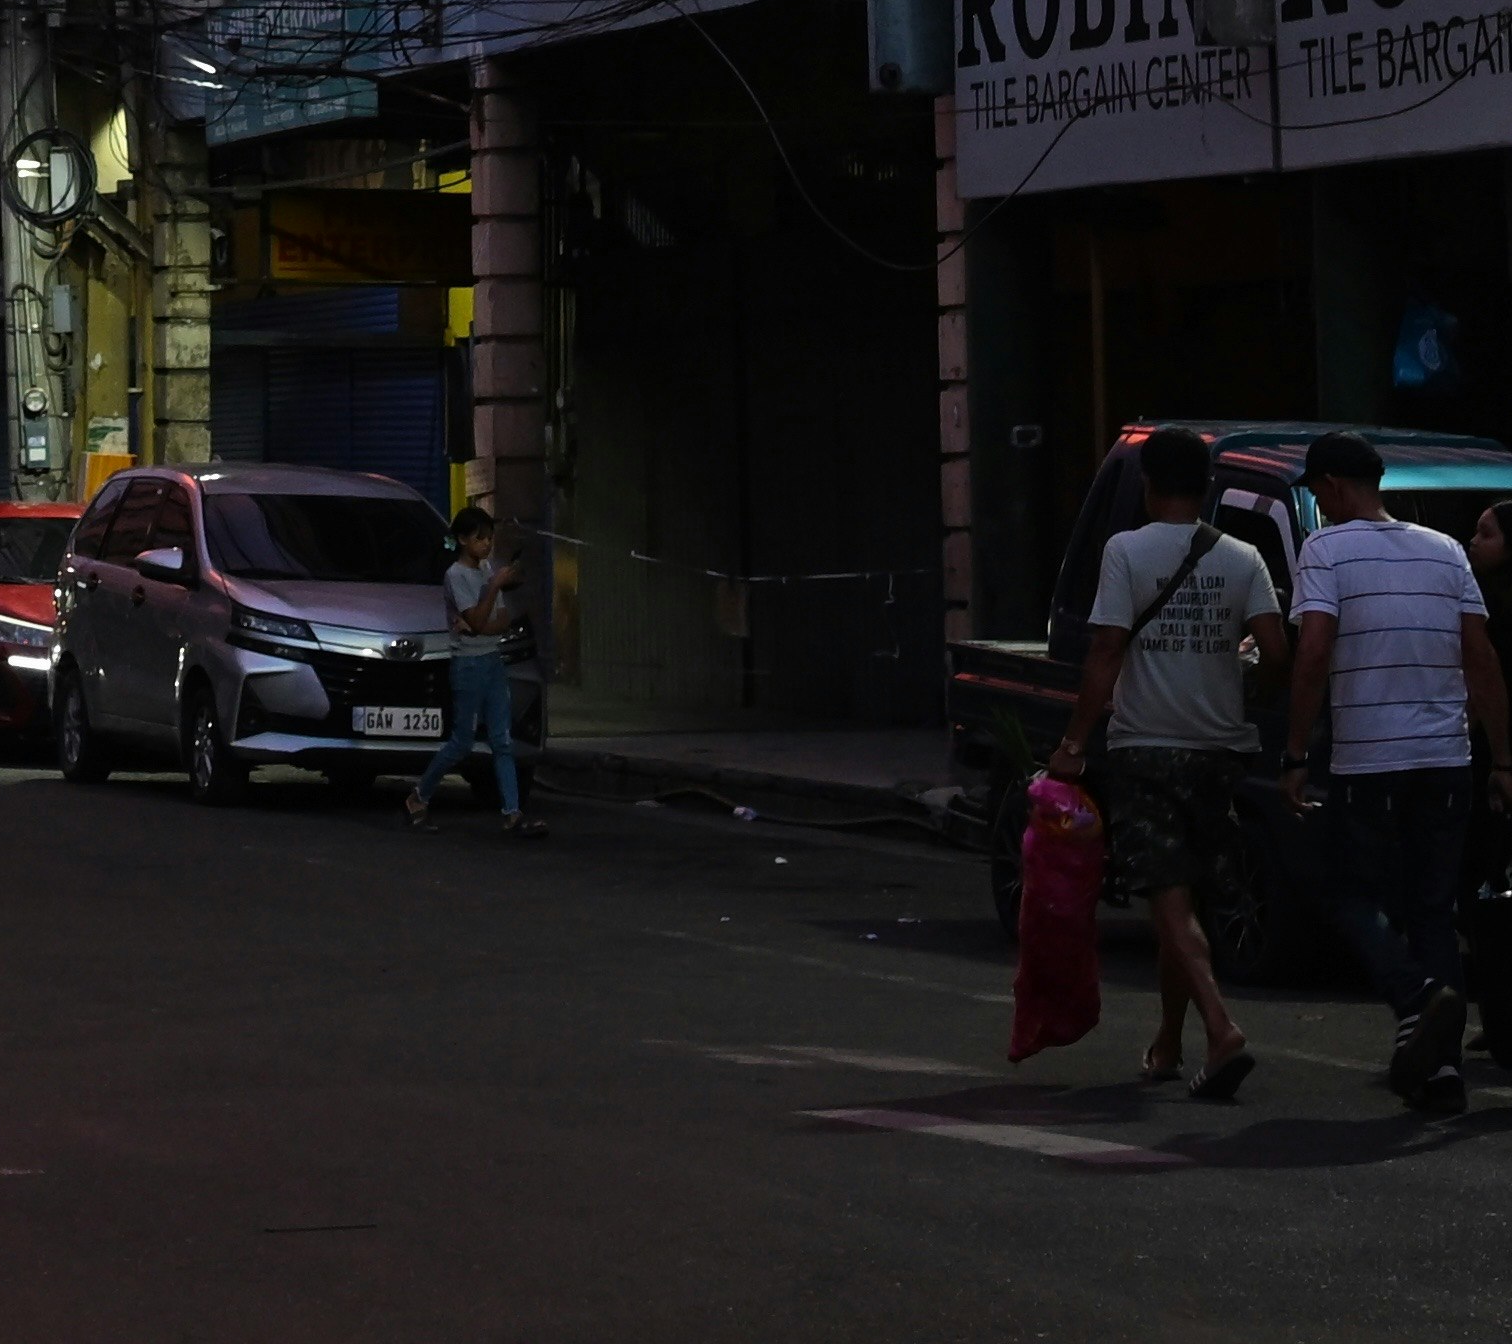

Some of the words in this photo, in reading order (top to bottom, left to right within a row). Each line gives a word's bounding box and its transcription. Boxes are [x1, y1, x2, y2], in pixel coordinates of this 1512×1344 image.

[970, 78, 1018, 131] TILE
[1025, 60, 1136, 125] BARGAIN
[1145, 46, 1251, 110] CENTER
[1299, 31, 1366, 99] TILE
[366, 712, 394, 730] GAW
[403, 714, 440, 732] 1230
